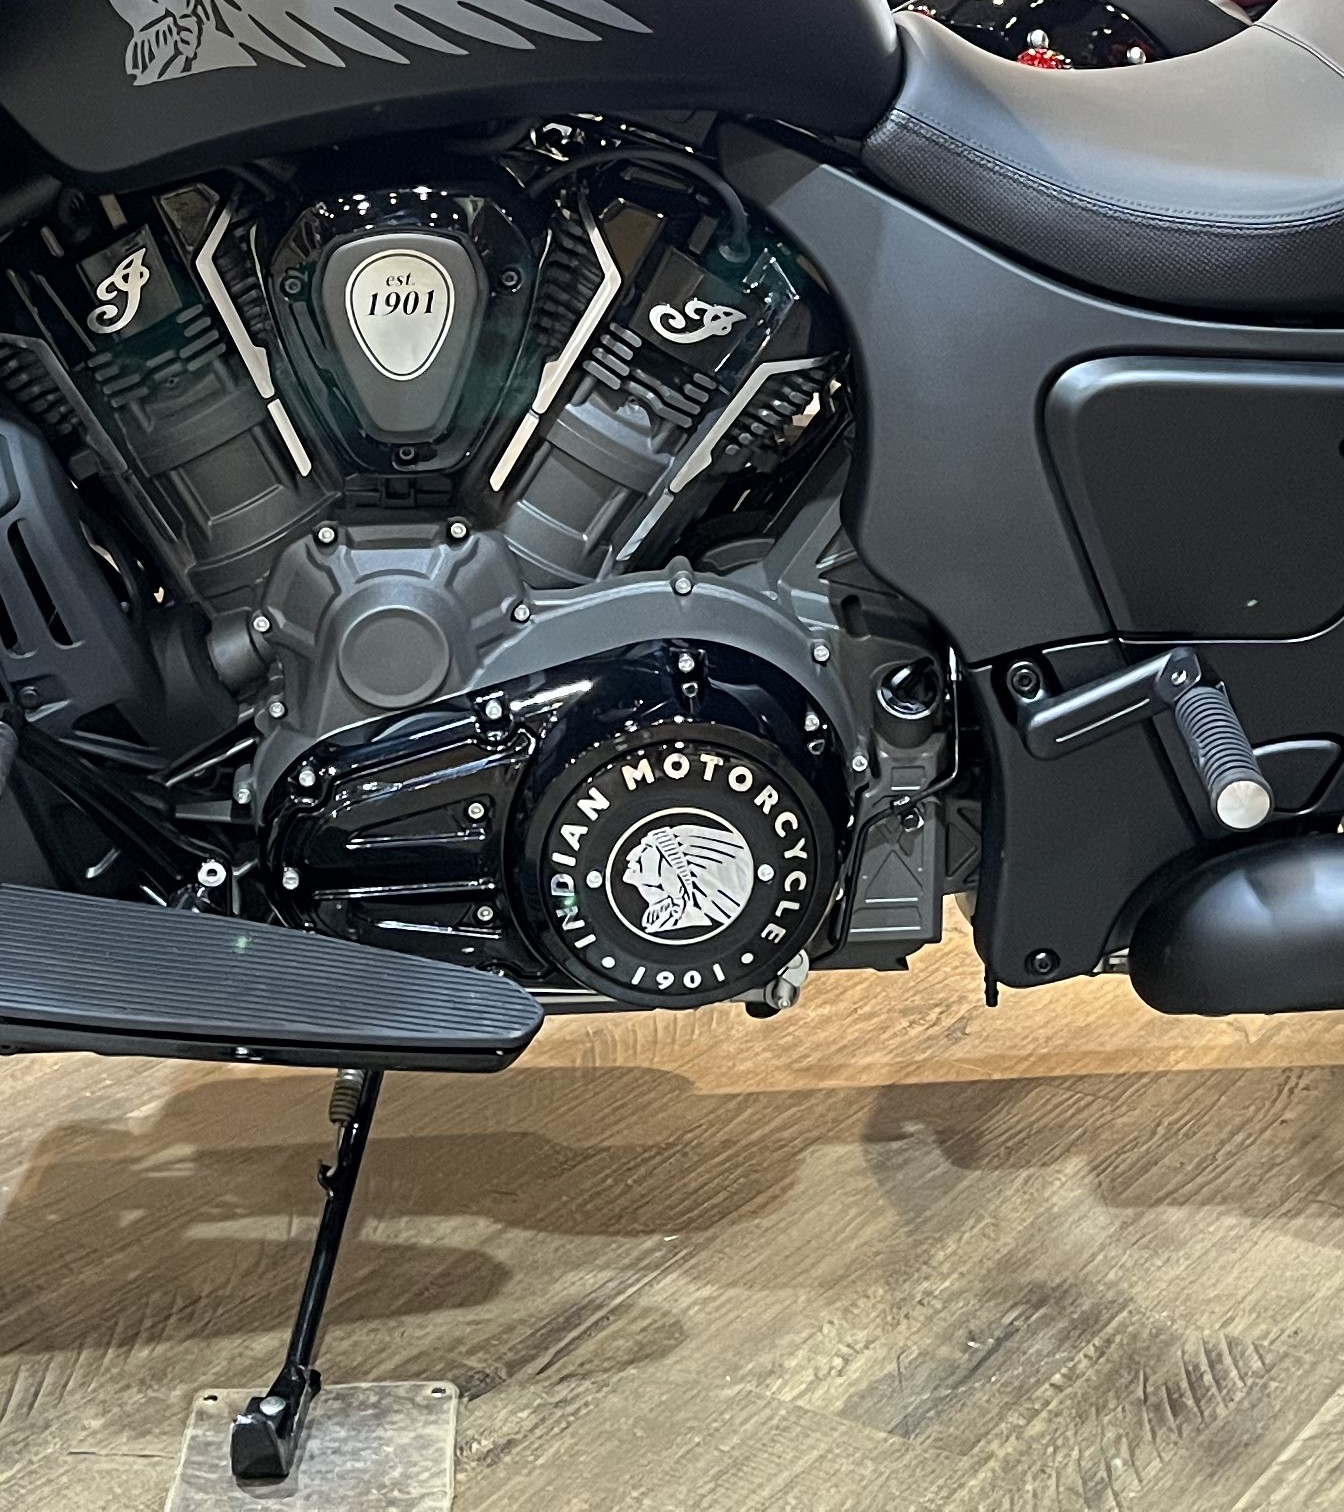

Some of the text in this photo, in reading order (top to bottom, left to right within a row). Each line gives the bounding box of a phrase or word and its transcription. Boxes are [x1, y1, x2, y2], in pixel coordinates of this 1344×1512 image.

[385, 272, 415, 287] est.
[367, 289, 435, 316] 1901
[551, 752, 807, 949] INDIAN MOTORCYCLE
[631, 965, 726, 990] 1901
